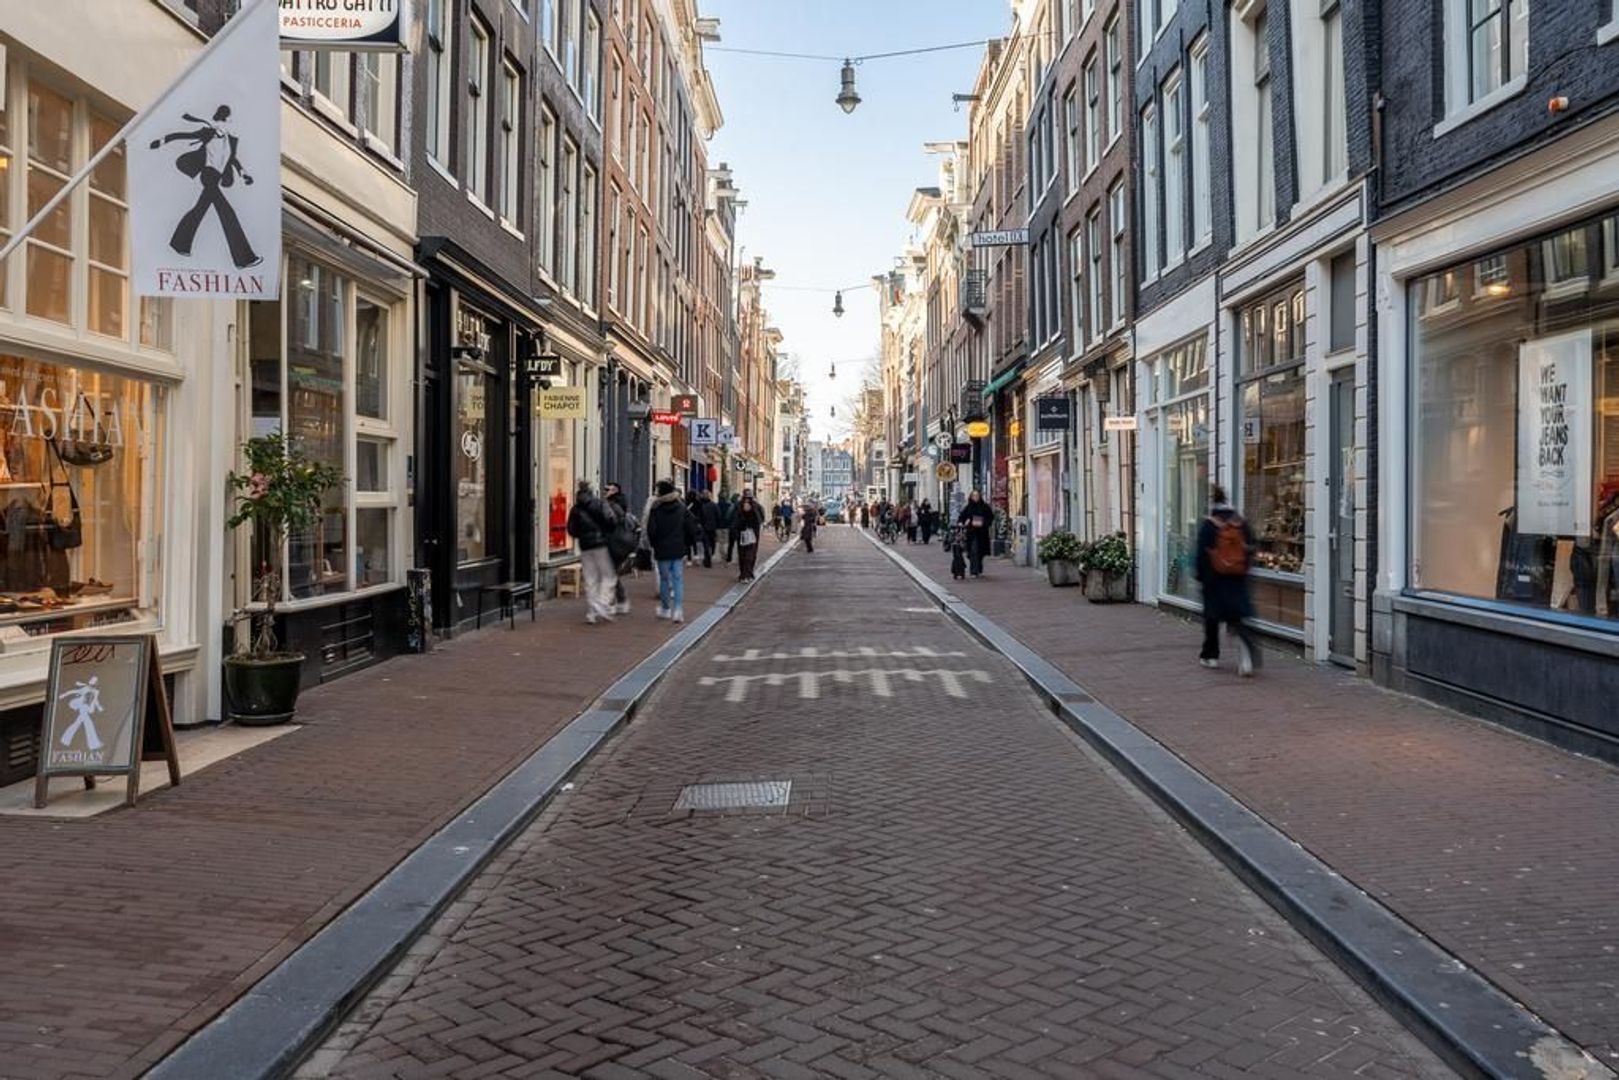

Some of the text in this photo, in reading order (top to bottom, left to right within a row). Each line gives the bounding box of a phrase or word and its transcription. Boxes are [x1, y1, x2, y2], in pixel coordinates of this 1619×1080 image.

[283, 16, 362, 28] PASTICCERIA
[157, 272, 264, 294] FASHIAN
[1540, 362, 1556, 383] WE
[1539, 383, 1568, 404] WANT
[544, 402, 580, 410] CHAPOT
[1539, 404, 1565, 425] YOUR
[696, 423, 711, 438] K
[1539, 425, 1569, 446] JEANS
[1538, 446, 1565, 467] BACK
